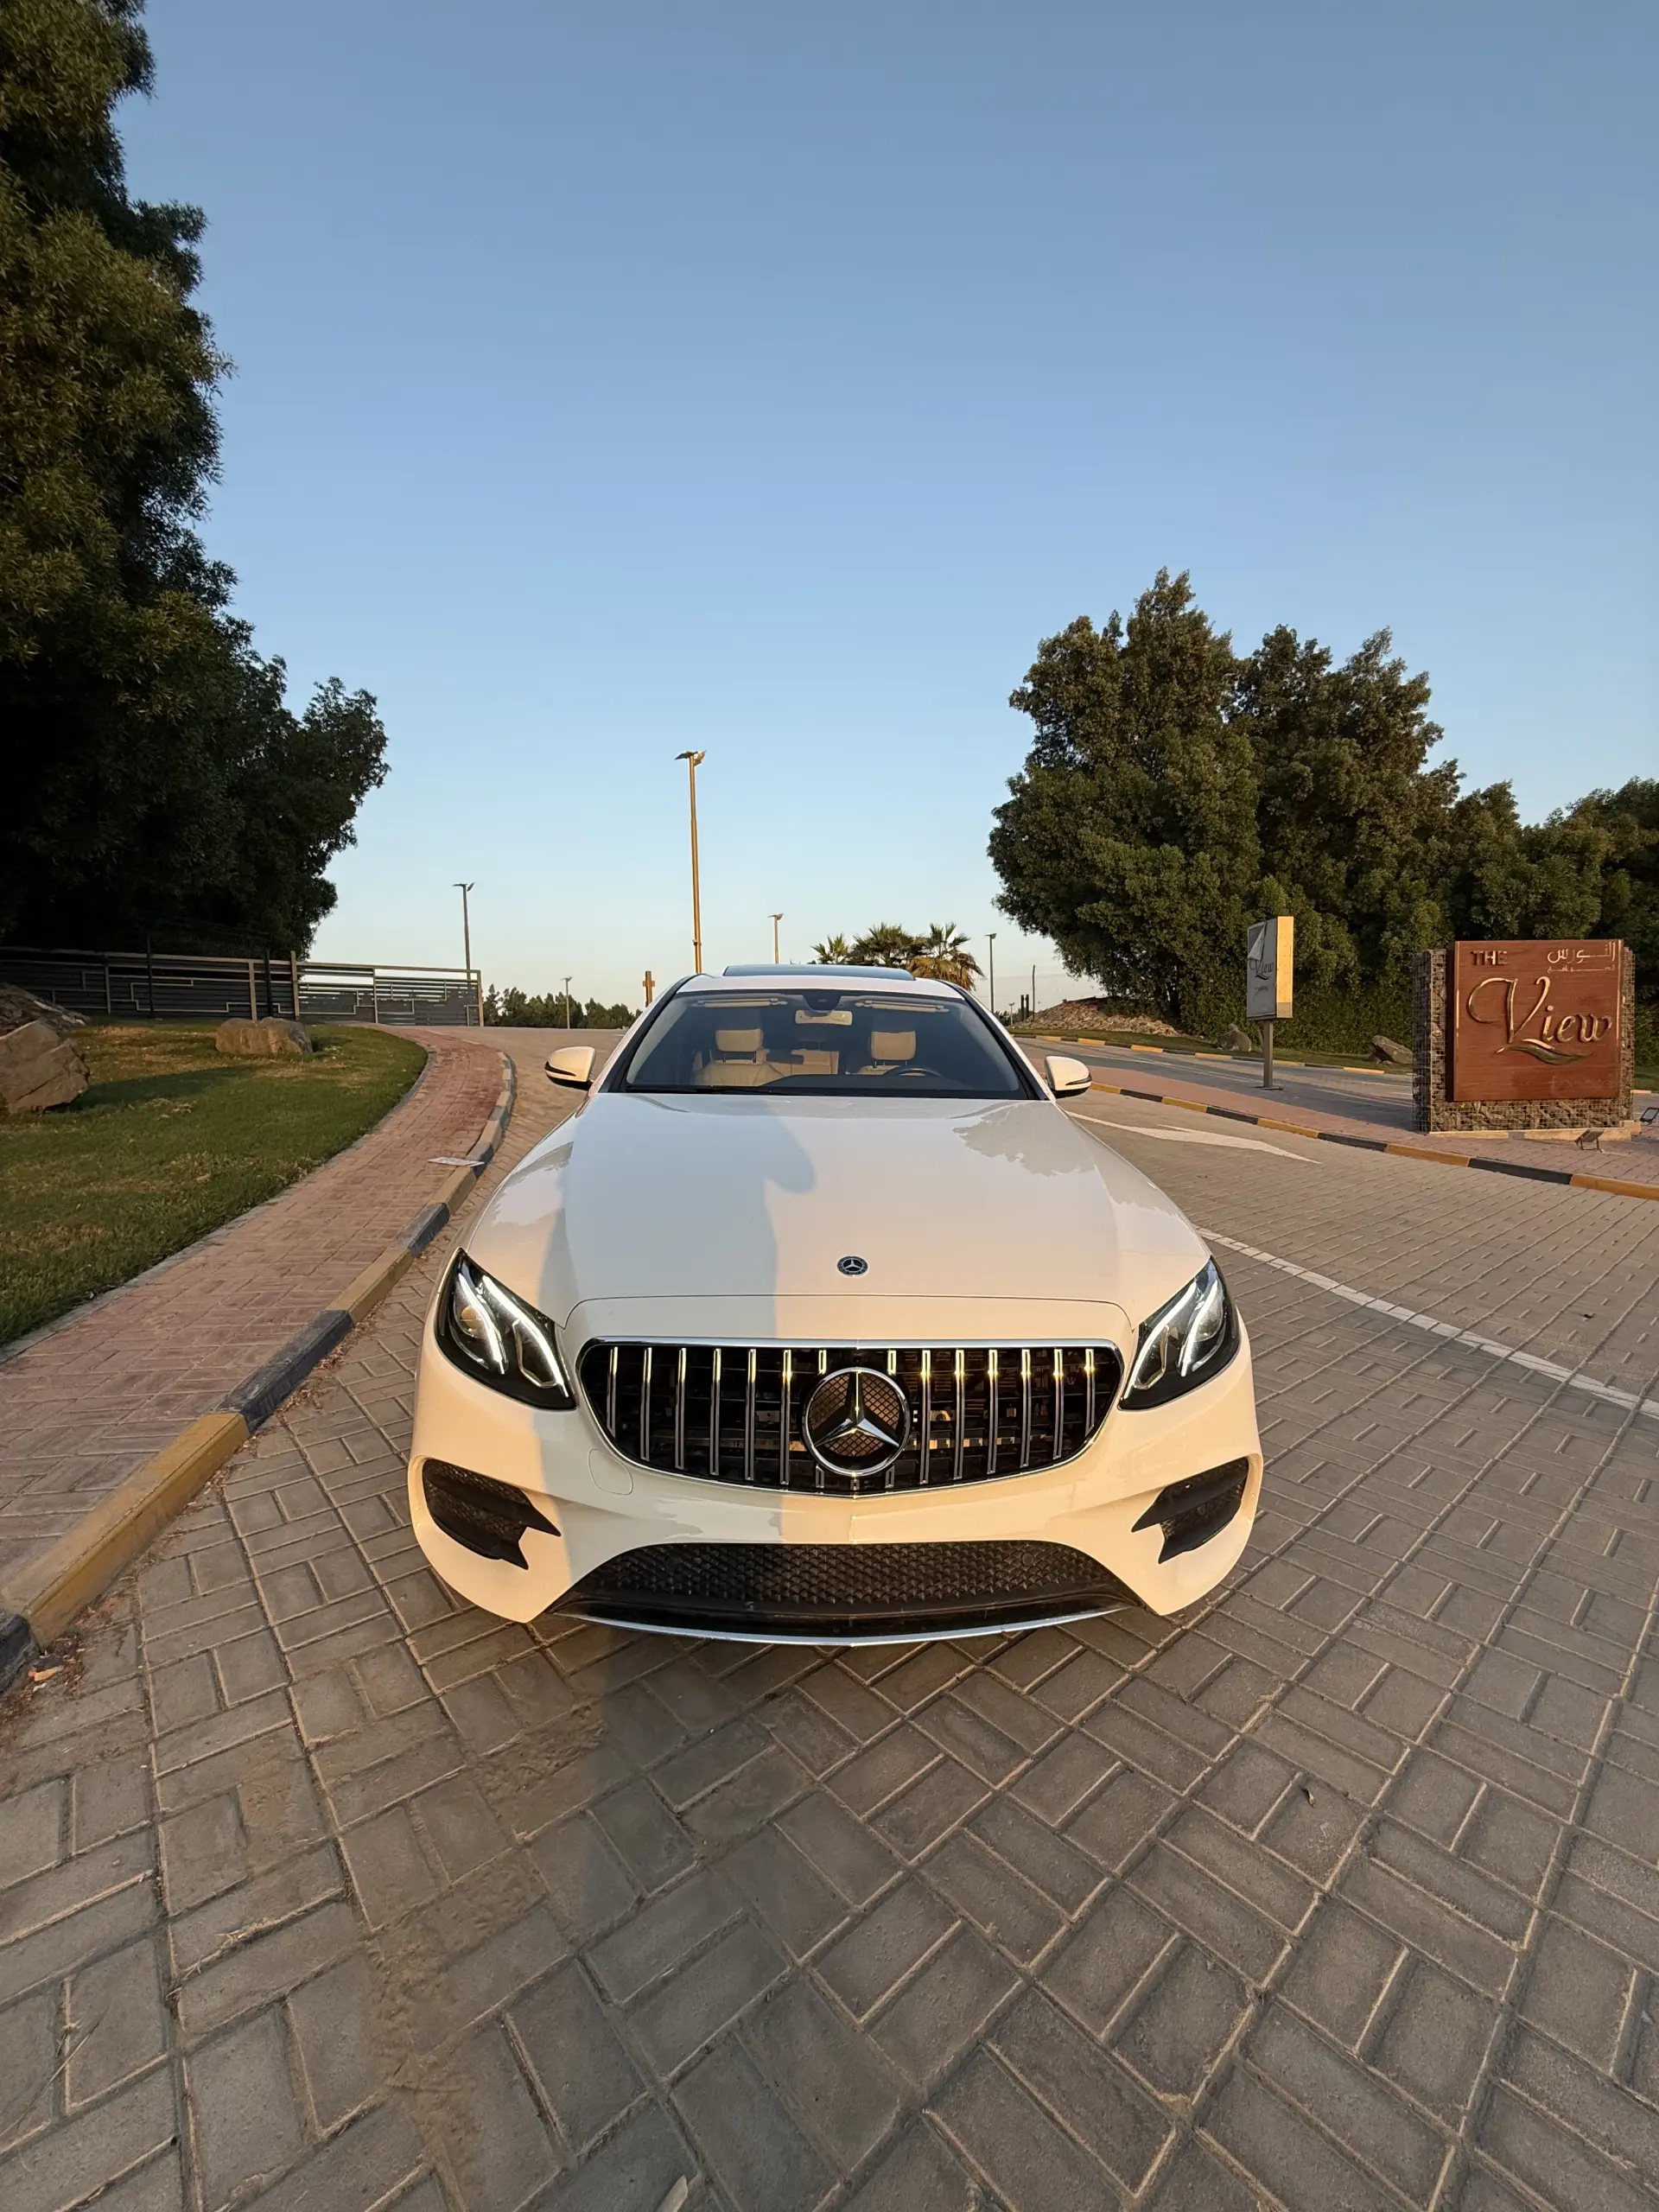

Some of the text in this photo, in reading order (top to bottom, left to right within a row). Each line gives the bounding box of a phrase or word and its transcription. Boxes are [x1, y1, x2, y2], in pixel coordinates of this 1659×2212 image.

[1470, 950, 1508, 966] THE
[1249, 959, 1274, 975] View
[1467, 976, 1612, 1044] View
